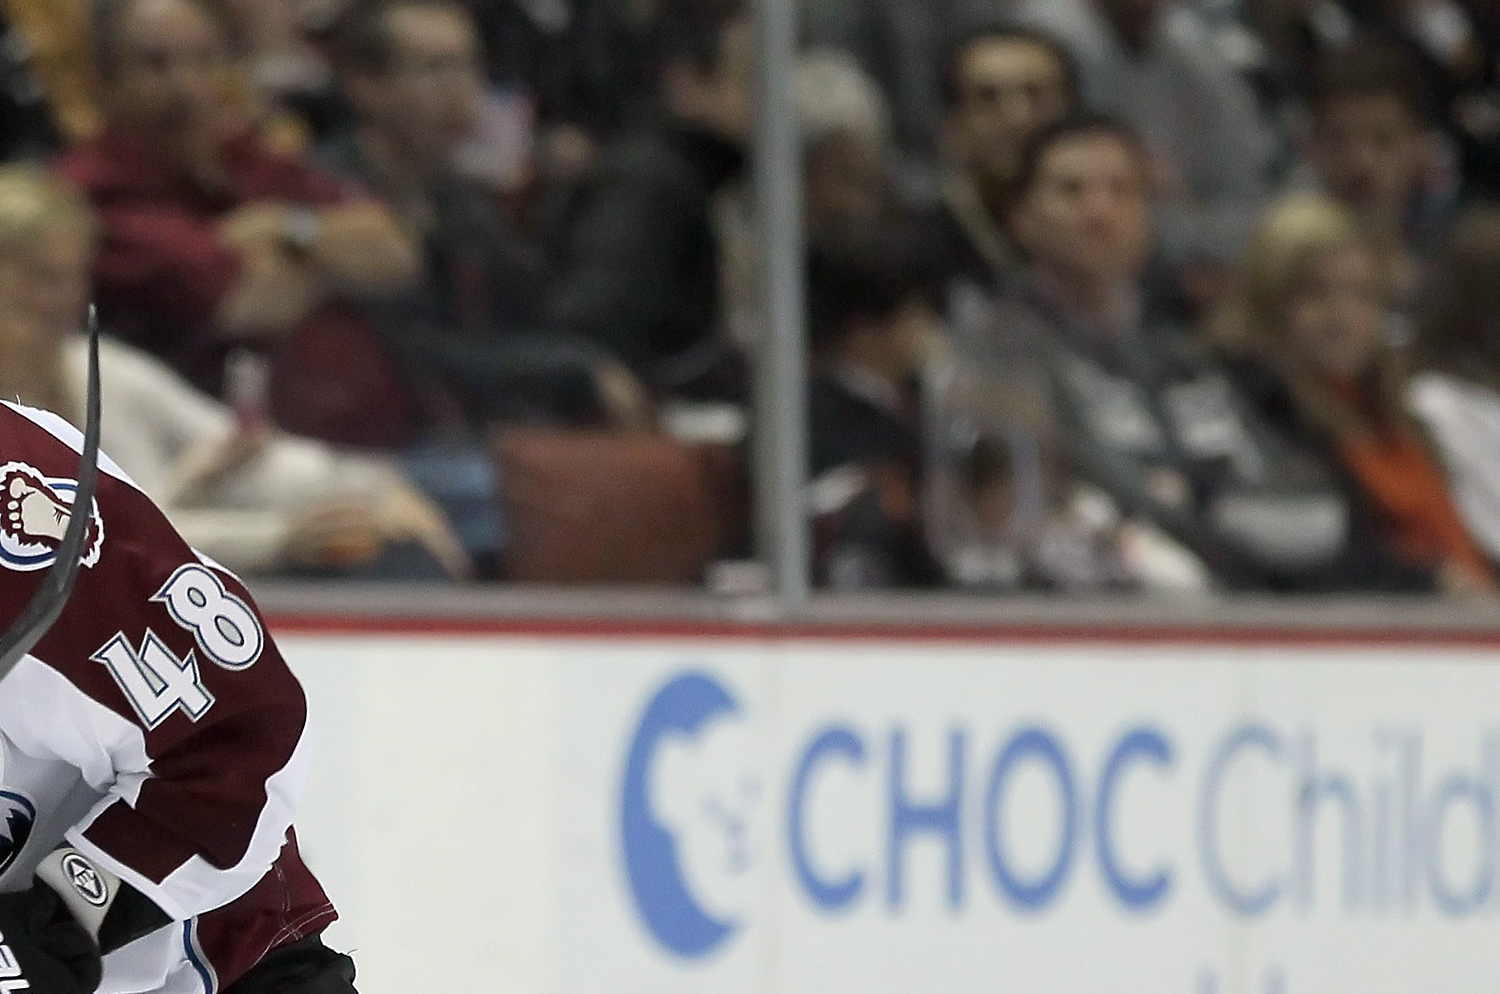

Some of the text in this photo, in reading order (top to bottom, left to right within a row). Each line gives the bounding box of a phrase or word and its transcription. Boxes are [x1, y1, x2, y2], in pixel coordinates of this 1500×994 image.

[88, 562, 264, 732] 48
[783, 722, 1500, 918] CHOC Child
